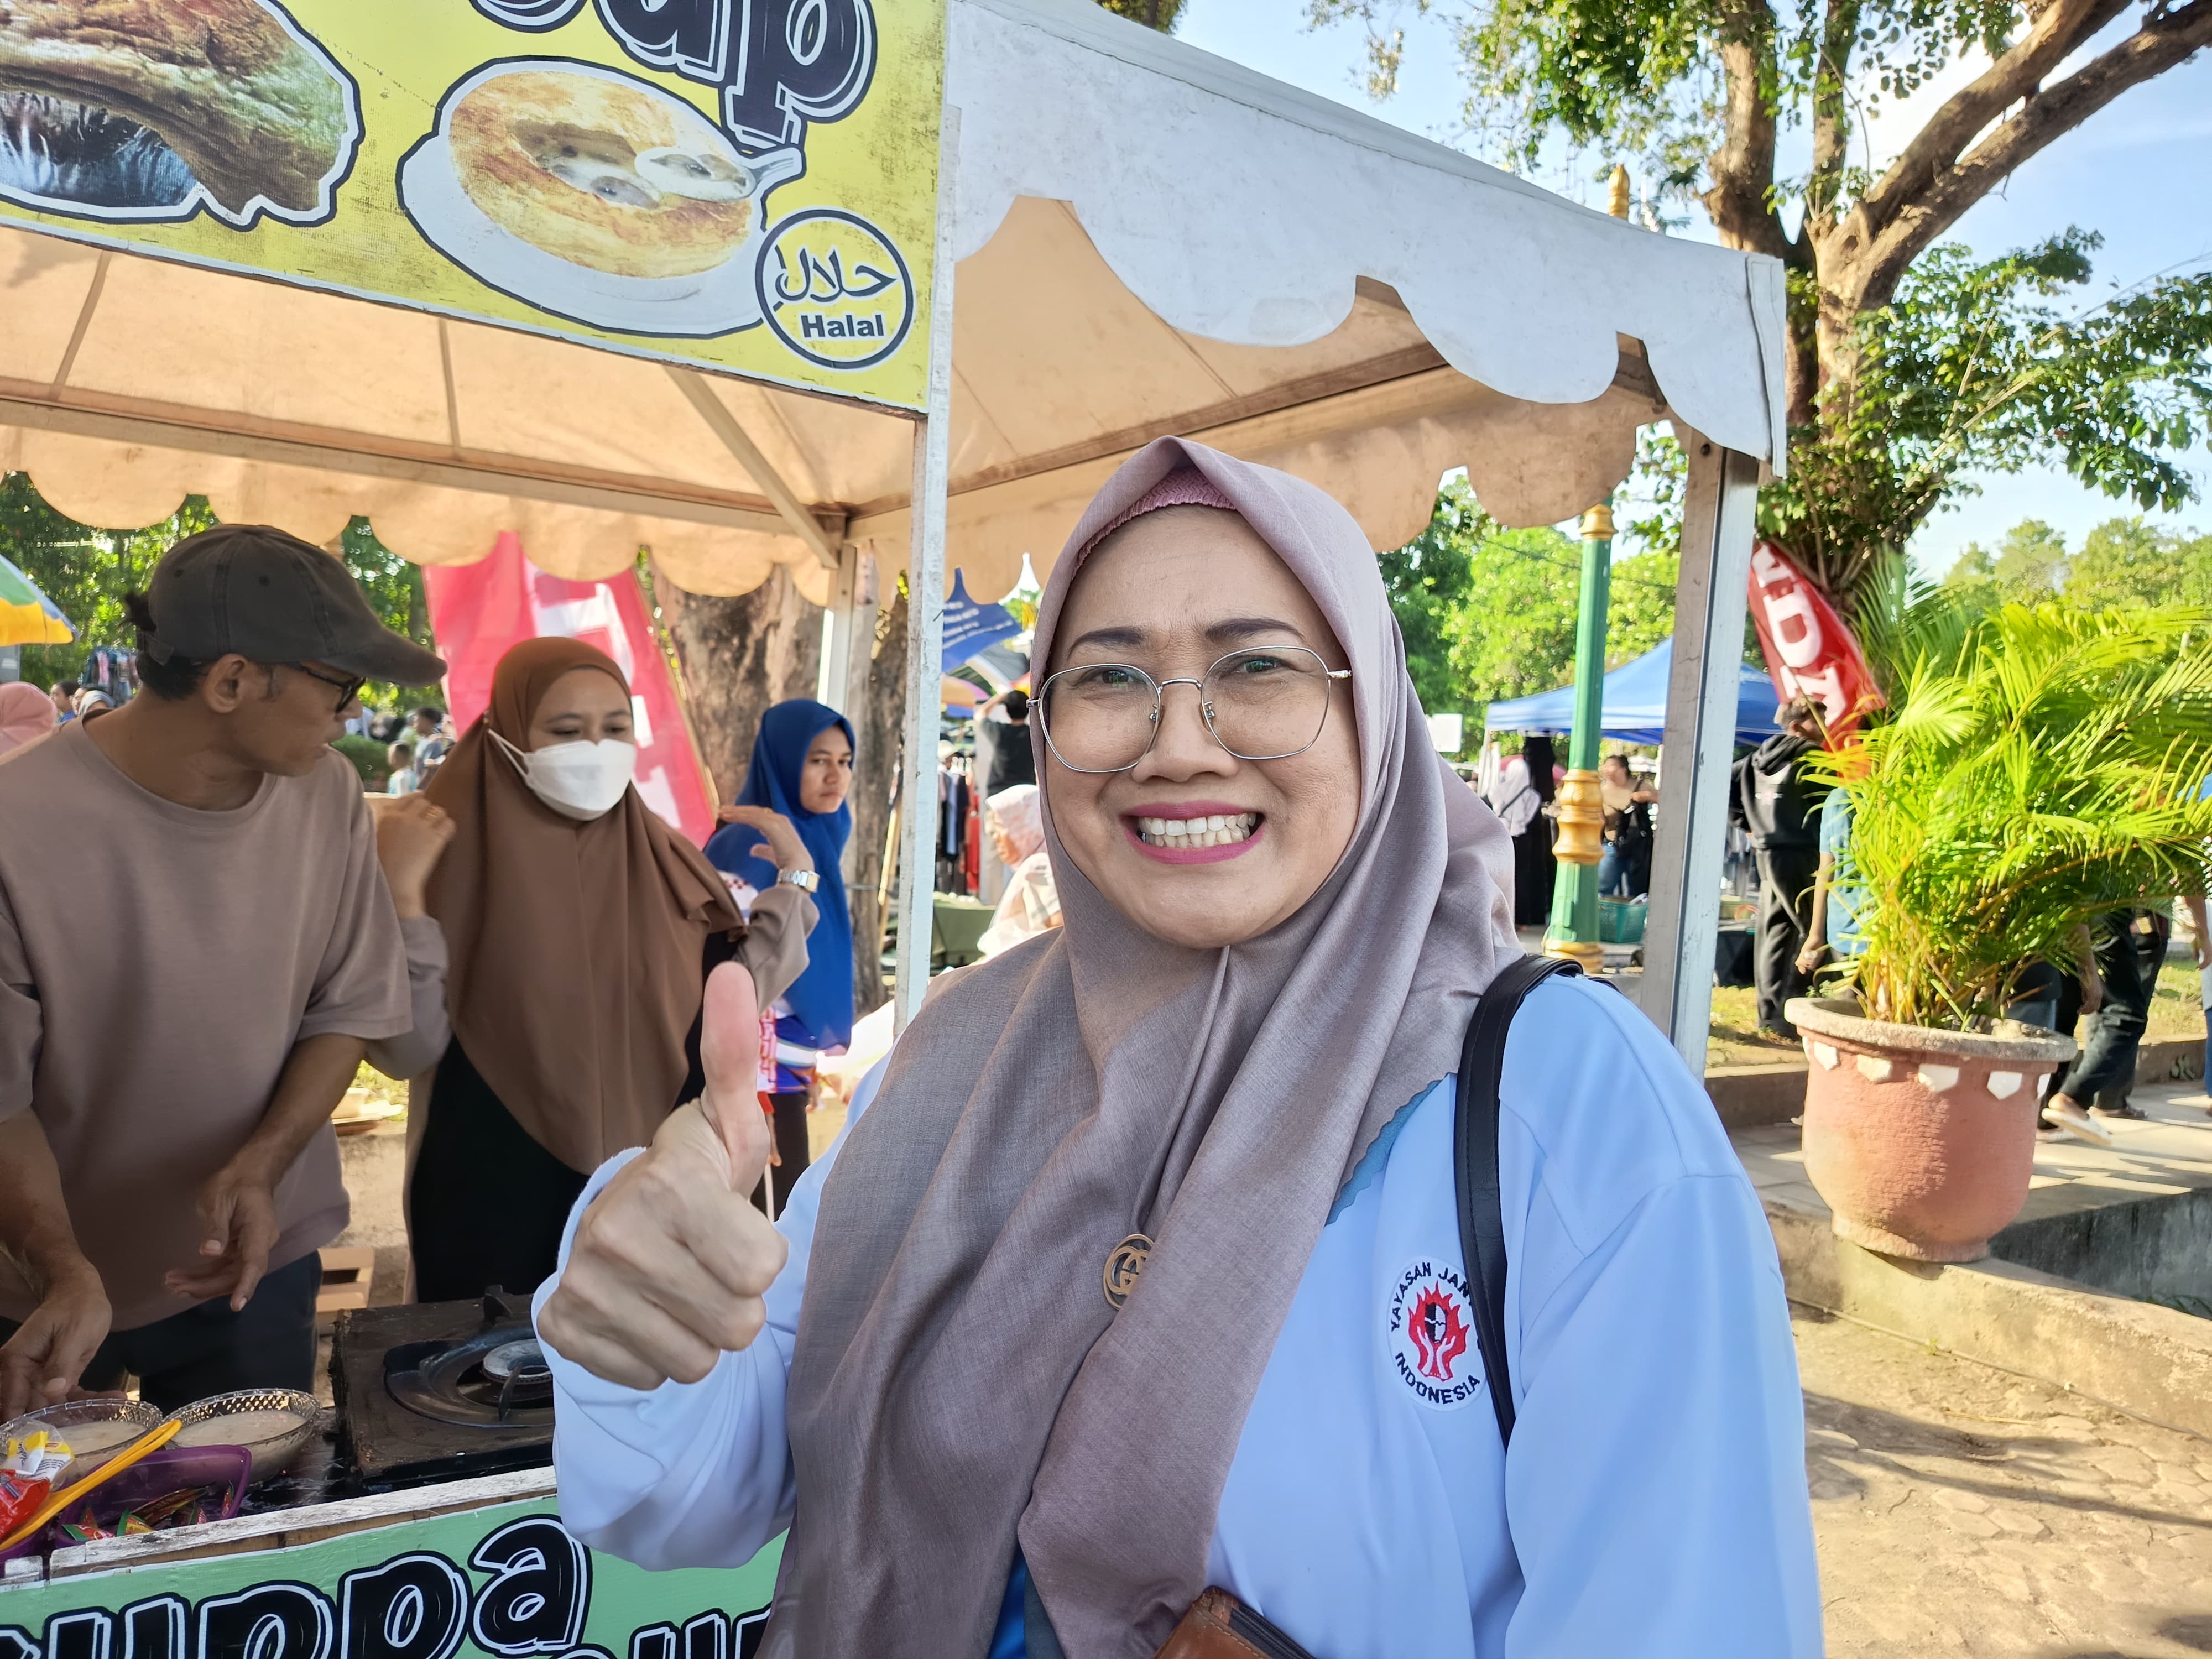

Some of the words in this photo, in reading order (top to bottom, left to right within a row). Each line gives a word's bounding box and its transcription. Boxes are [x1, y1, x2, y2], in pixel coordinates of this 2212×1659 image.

[775, 248, 897, 302] حلال
[801, 315, 884, 337] Halal
[1391, 1262, 1431, 1332] YAYASAN
[1438, 1267, 1472, 1306] JAN
[1395, 1352, 1480, 1405] INDONESIA
